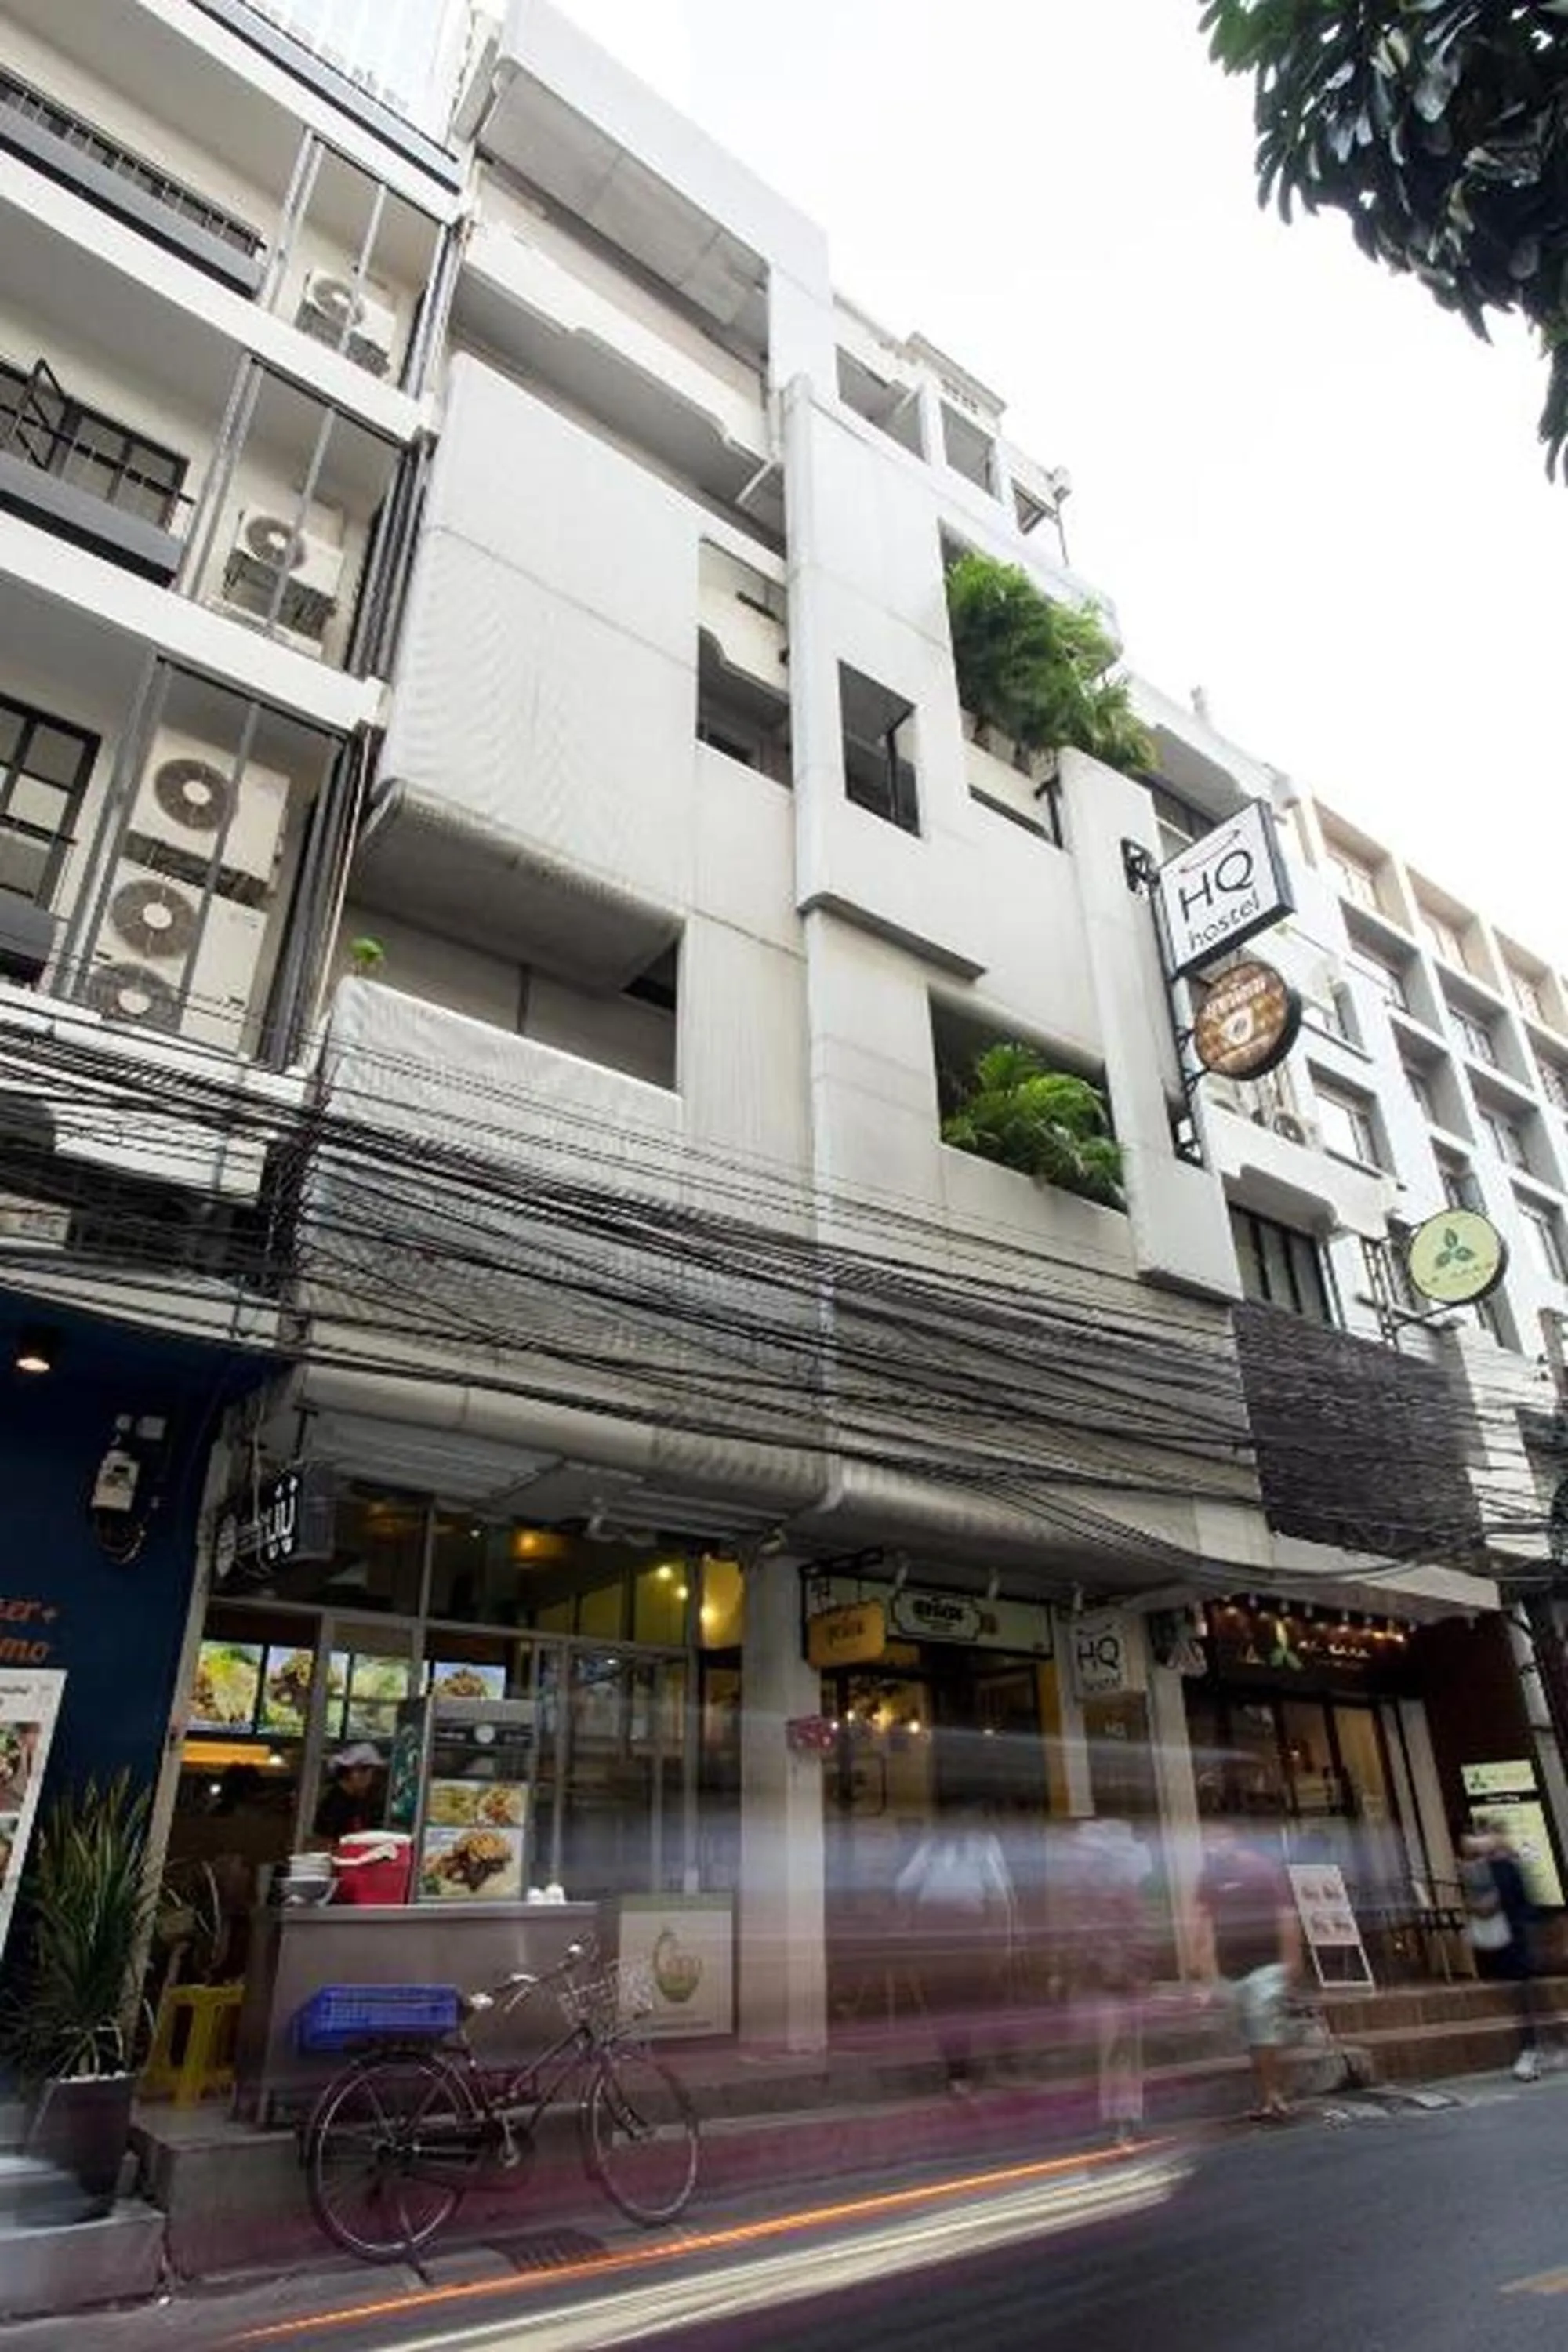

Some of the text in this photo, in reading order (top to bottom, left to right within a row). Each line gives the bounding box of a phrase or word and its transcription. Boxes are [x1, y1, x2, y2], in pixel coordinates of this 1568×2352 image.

[1178, 850, 1254, 923] HQ
[1189, 889, 1260, 951] hostel
[1077, 1636, 1120, 1672] HQ
